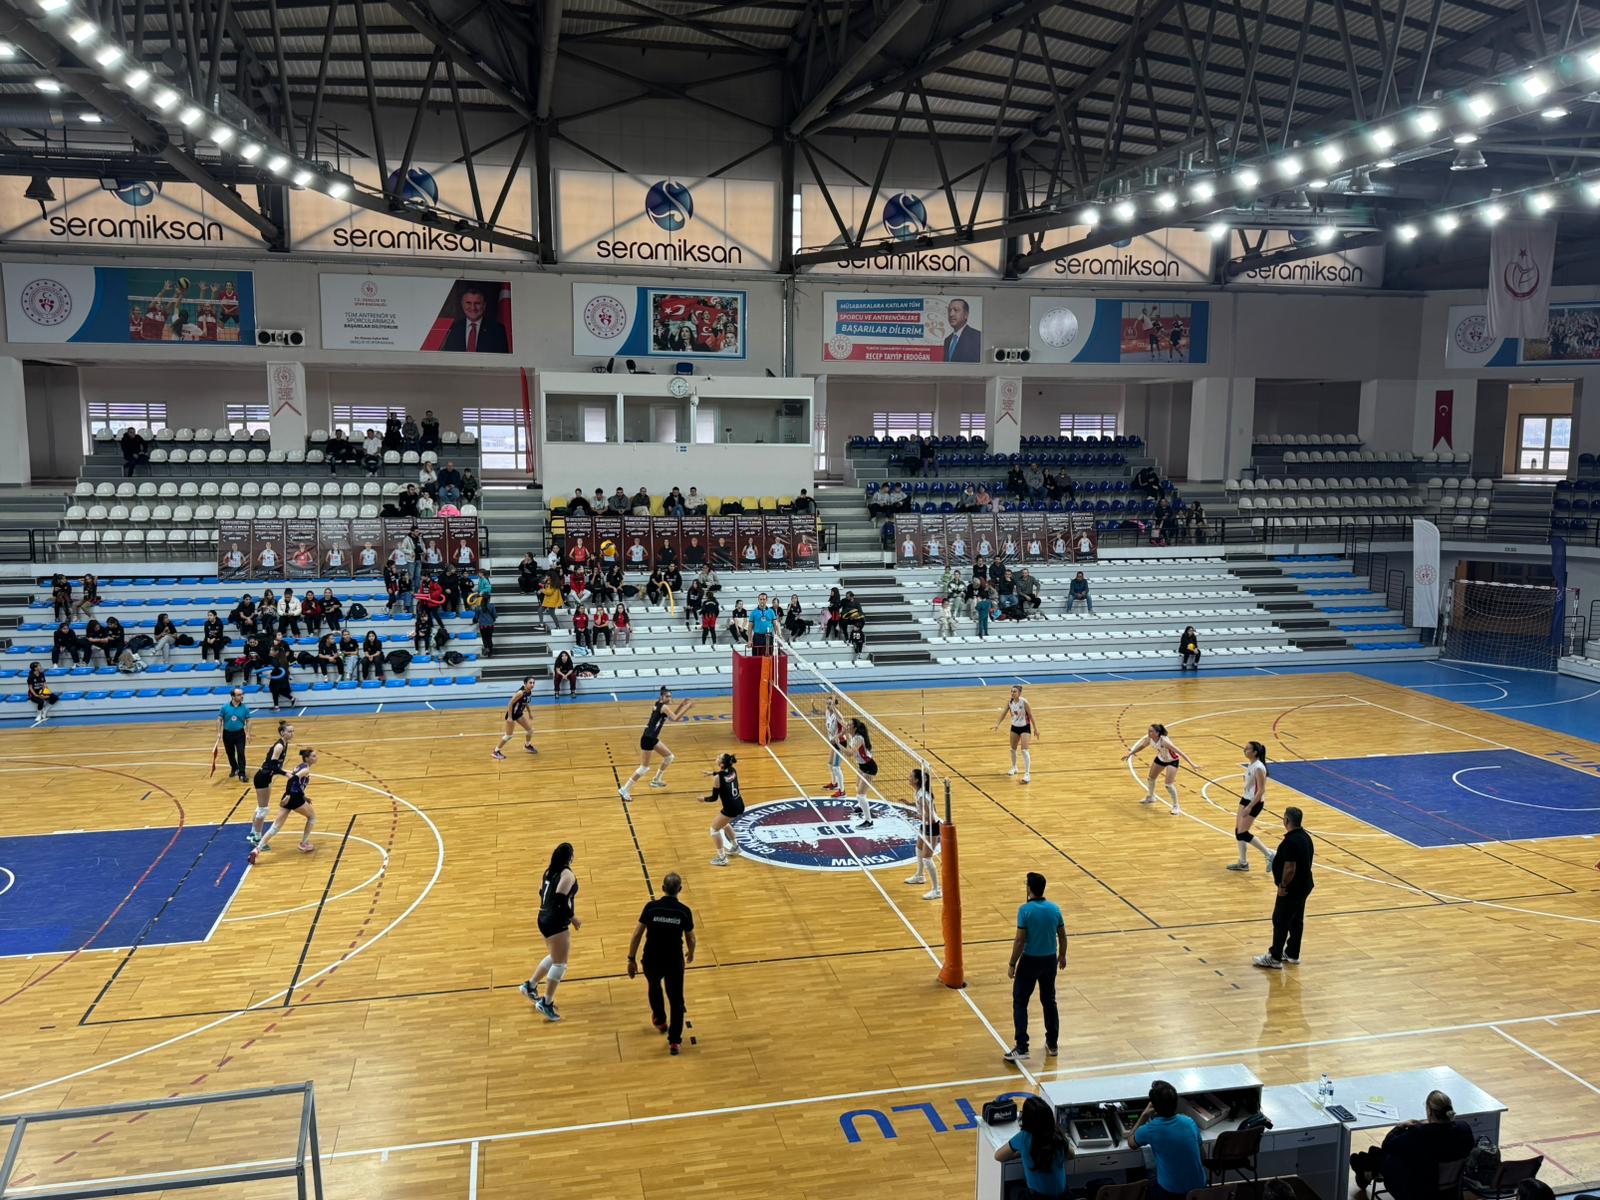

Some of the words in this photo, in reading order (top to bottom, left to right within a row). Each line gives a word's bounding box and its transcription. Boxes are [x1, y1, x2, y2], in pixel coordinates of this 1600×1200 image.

[50, 214, 223, 241] seramiksan
[596, 239, 742, 264] seramiksan
[1054, 255, 1180, 277] seramiksan
[841, 324, 888, 334] BAŞARILAR
[865, 352, 882, 360] RECEP
[903, 352, 931, 361] ERDOĞAN
[731, 781, 739, 797] 6
[831, 854, 895, 867] MANİSA
[542, 880, 550, 905] 7
